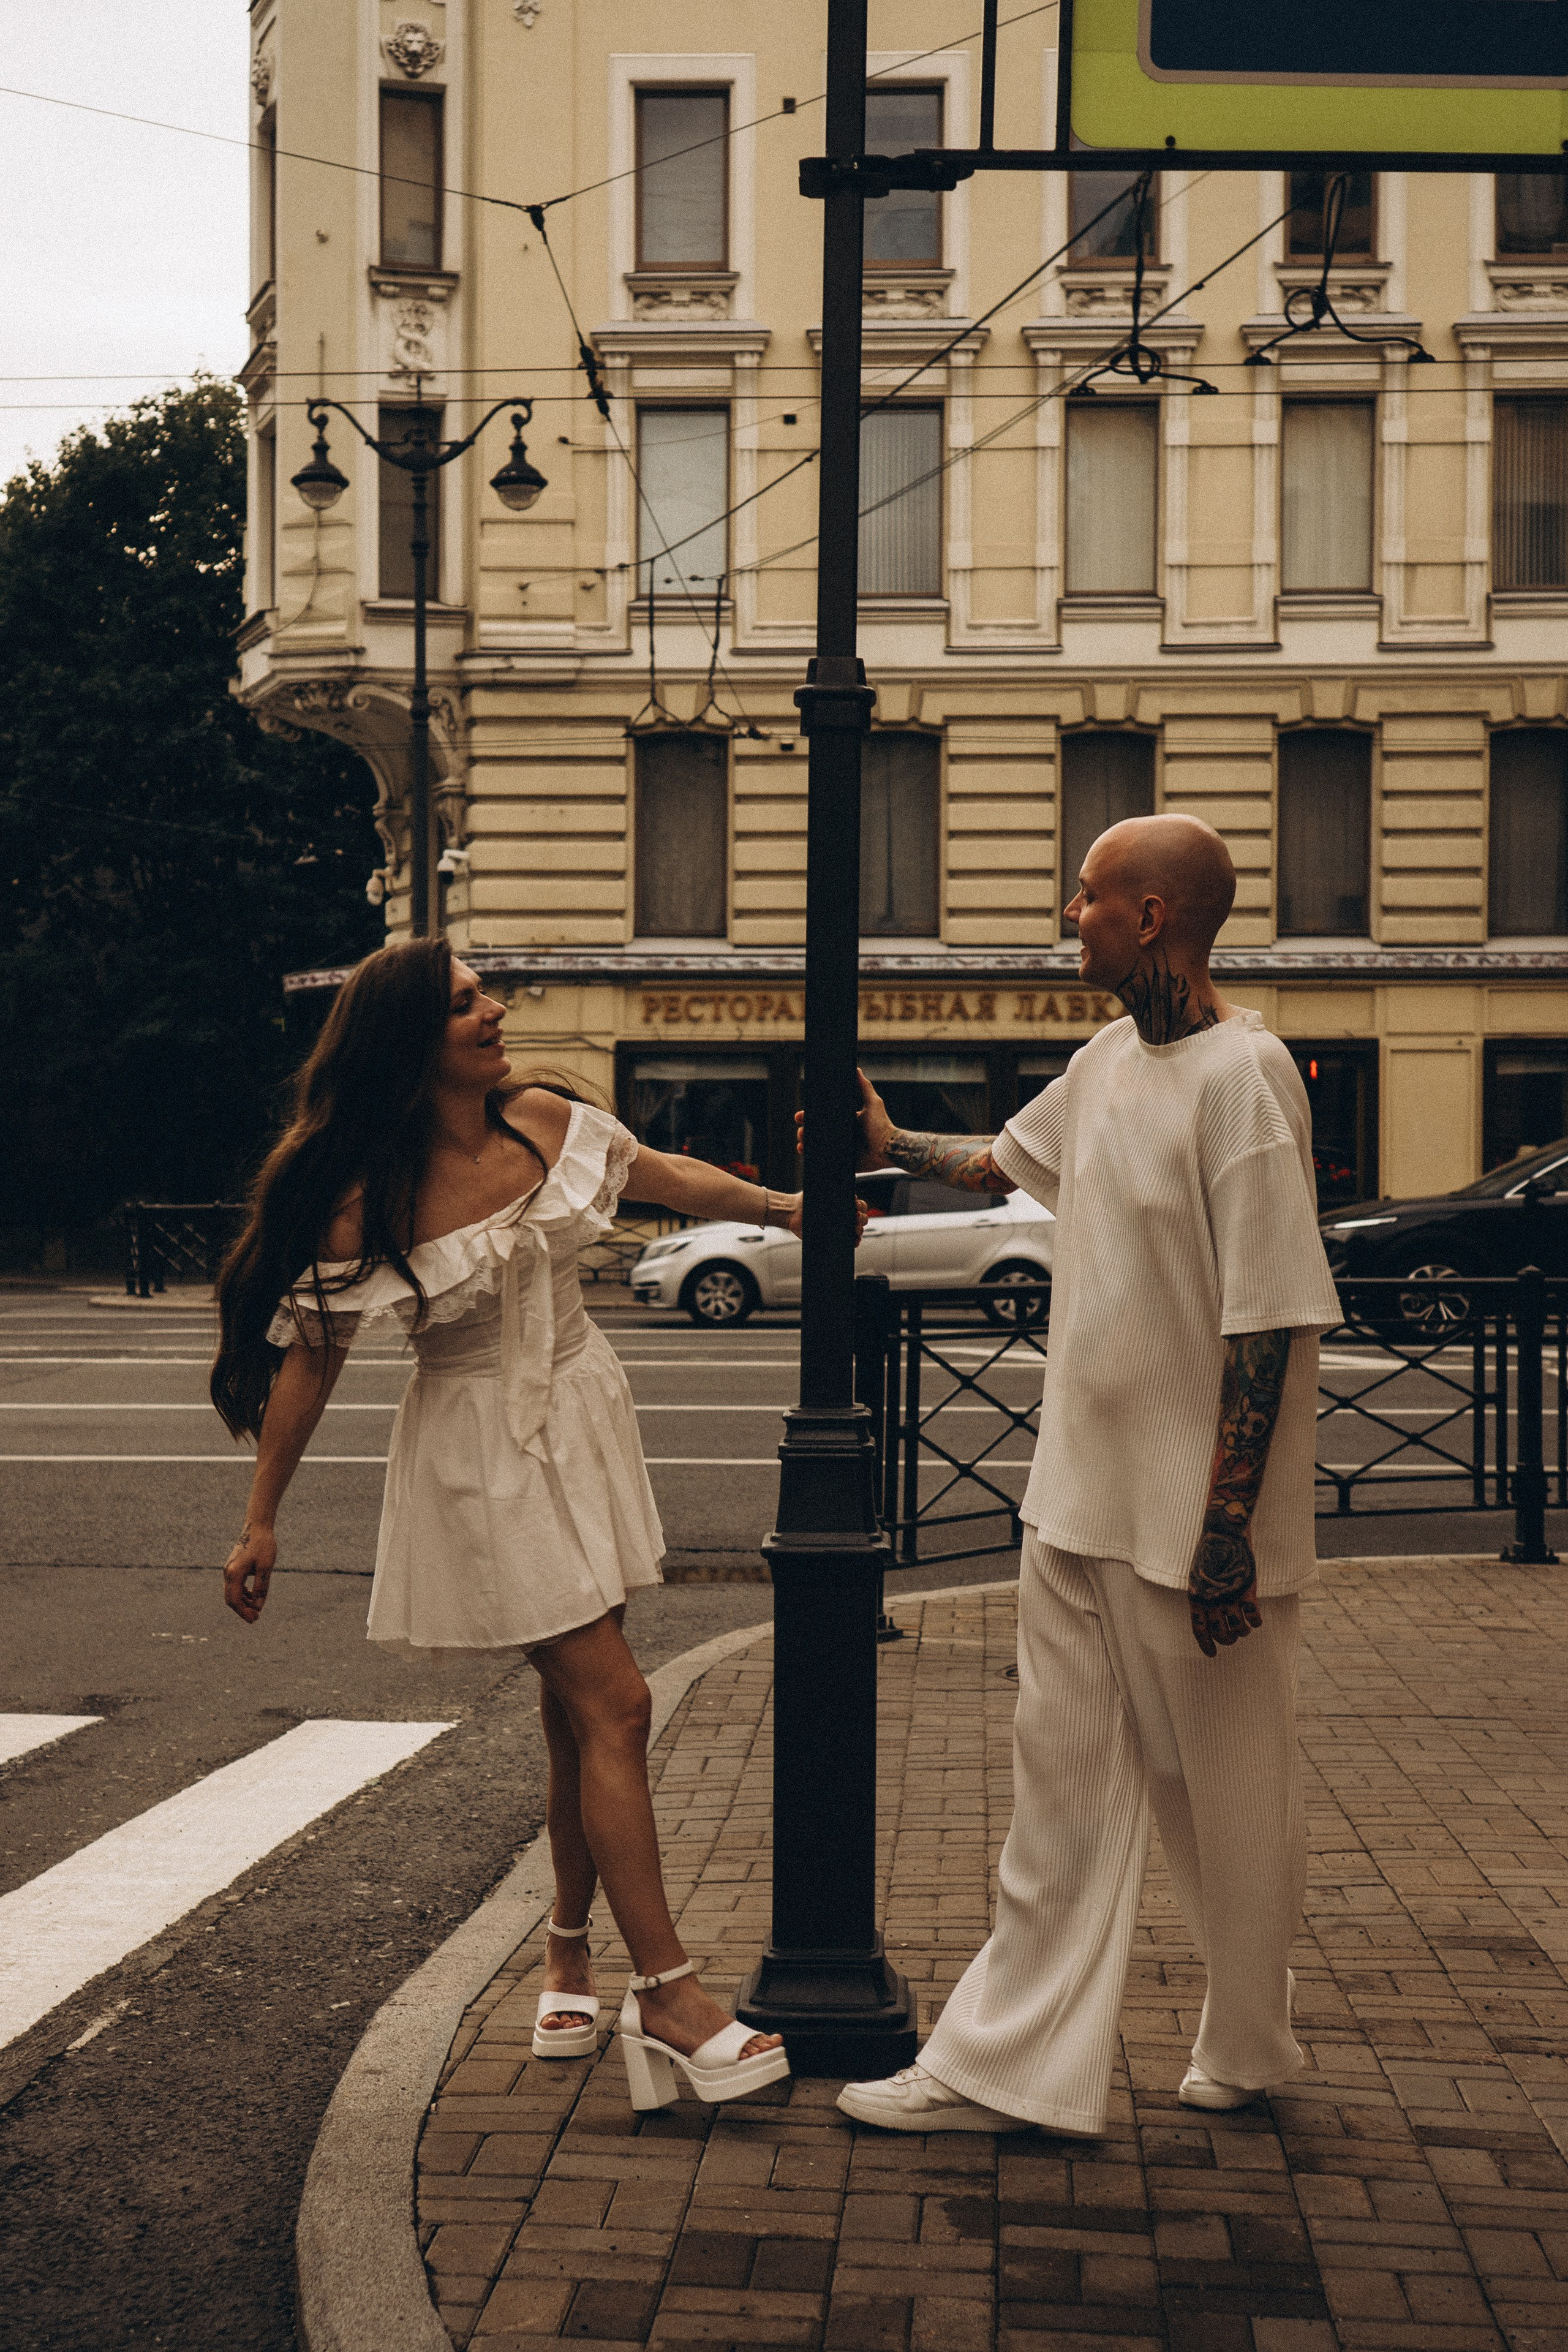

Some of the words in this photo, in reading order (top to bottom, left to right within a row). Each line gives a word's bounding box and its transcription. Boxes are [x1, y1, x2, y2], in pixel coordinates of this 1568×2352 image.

[642, 992, 805, 1023] РЕСТОРА
[858, 992, 997, 1022] ЫБНАЯ
[1014, 992, 1129, 1023] ЛАВК
